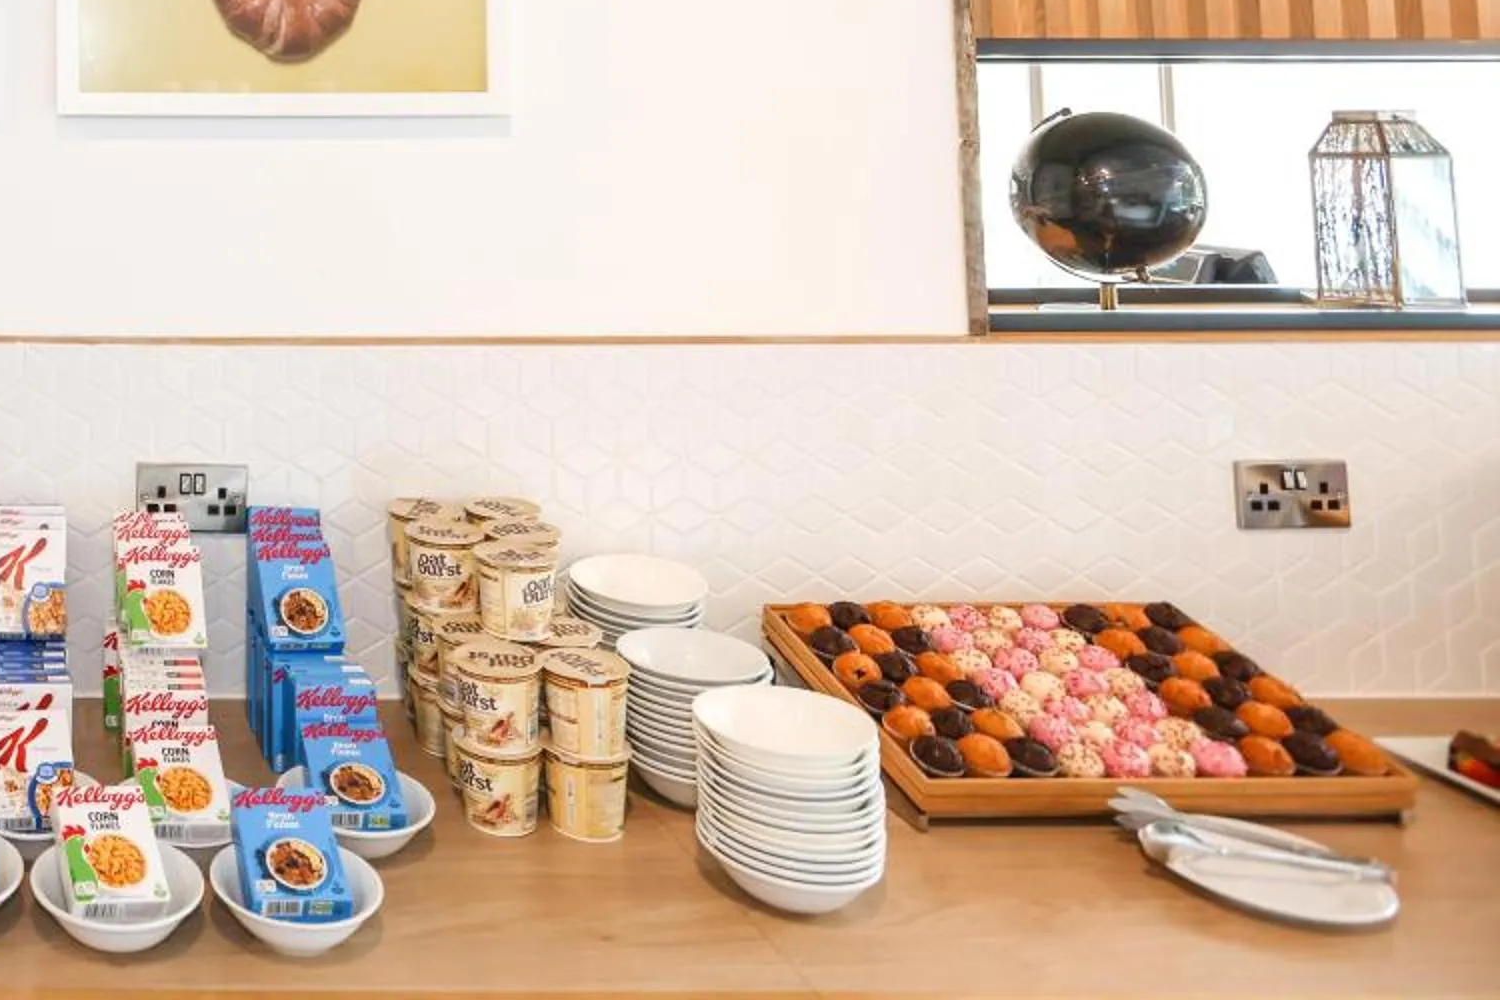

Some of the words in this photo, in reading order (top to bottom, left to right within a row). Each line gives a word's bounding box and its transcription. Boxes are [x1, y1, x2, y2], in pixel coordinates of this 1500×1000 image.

[125, 692, 208, 719] Kellogg's
[57, 782, 145, 811] Kellogg's
[234, 787, 326, 813] Kellogg's
[88, 811, 119, 823] CORN
